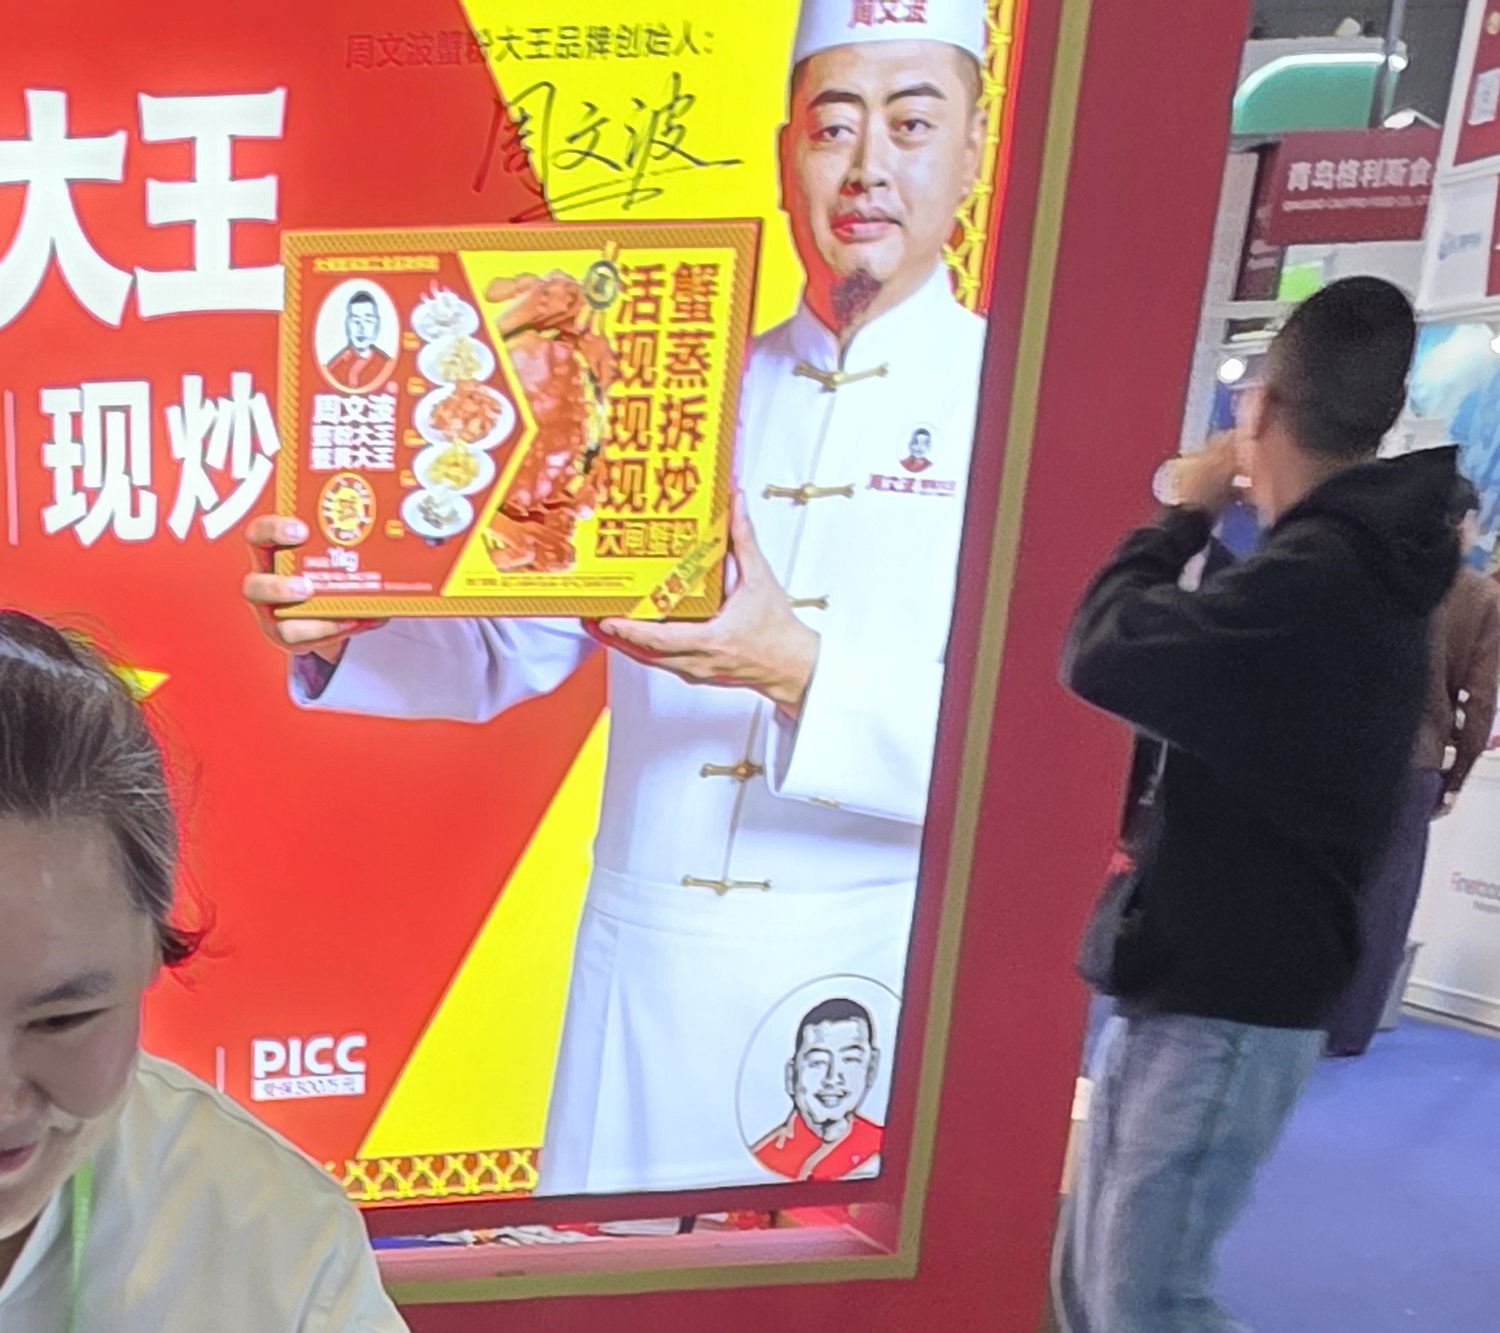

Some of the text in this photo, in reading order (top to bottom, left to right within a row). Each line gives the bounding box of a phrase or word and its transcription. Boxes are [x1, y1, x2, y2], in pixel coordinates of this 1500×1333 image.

[617, 262, 720, 325] 活蟹
[614, 328, 718, 389] 现蒸
[606, 393, 708, 452] 现拆
[40, 372, 280, 547] 现炒
[602, 456, 701, 514] 现炒
[252, 1034, 367, 1079] PICC
